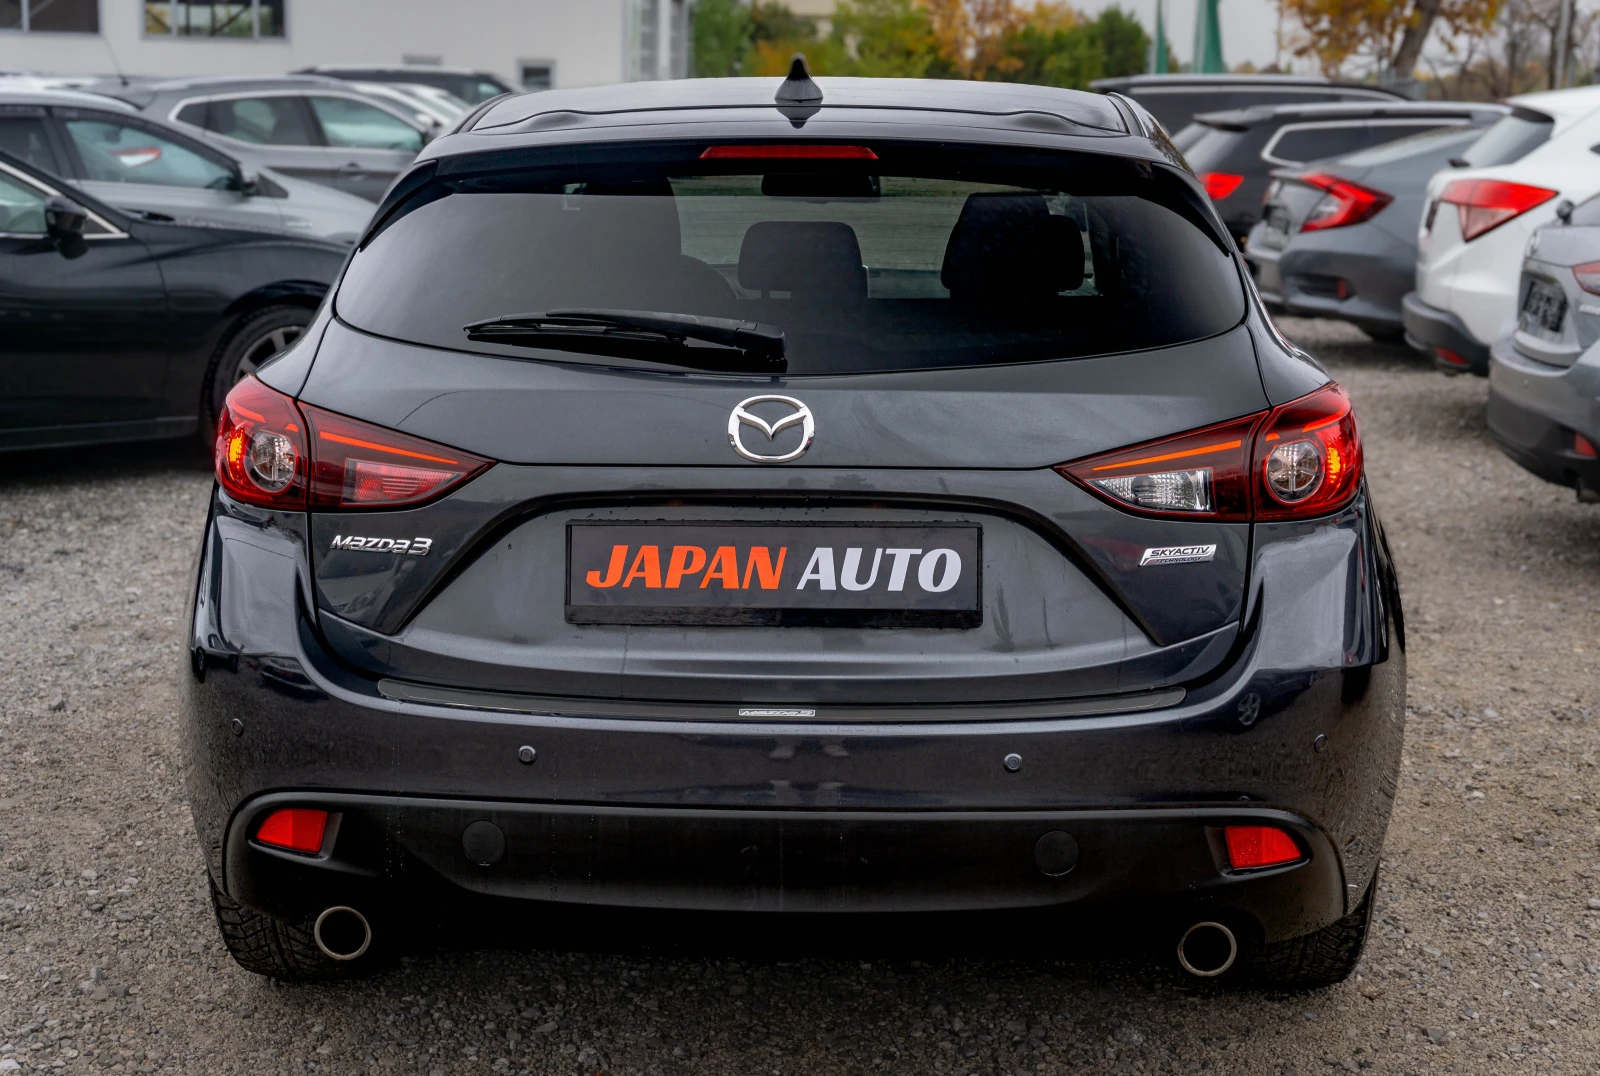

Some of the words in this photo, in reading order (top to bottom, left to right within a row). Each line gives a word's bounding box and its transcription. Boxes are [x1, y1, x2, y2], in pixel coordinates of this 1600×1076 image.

[1150, 546, 1210, 557] SKYACTIV
[586, 544, 787, 590] JAPAN
[796, 547, 962, 592] AUTO
